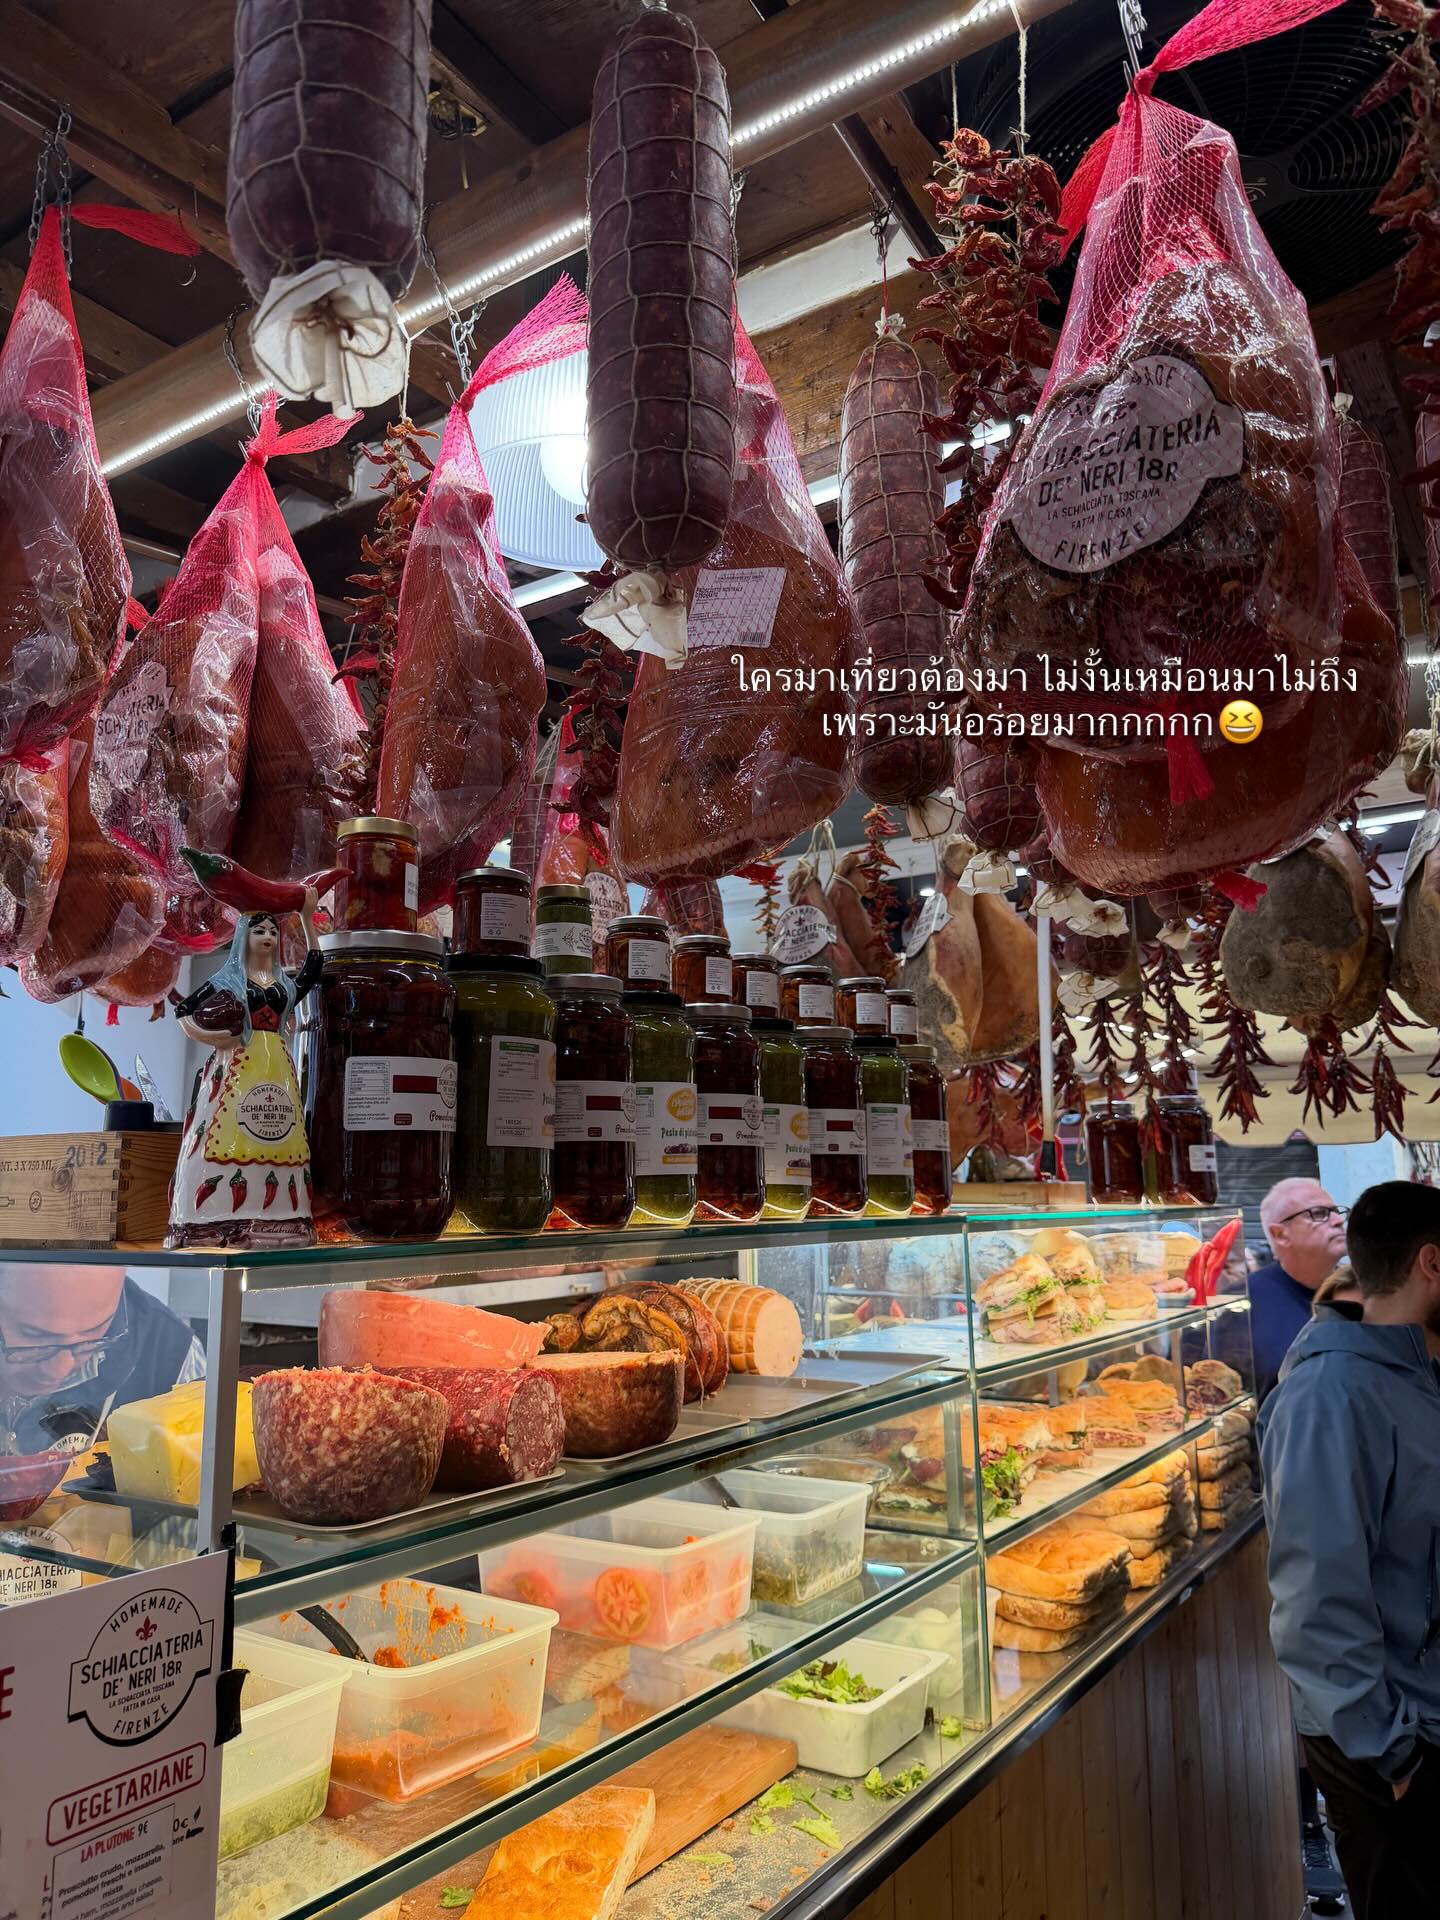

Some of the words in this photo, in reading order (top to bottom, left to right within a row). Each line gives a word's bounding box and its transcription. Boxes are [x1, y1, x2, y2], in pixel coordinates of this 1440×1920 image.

[1038, 476, 1072, 507] DE'
[1081, 460, 1126, 497] NERI
[1136, 455, 1179, 483] 18R
[1061, 495, 1114, 518] SCHIACCIATA
[1118, 487, 1161, 502] TOSCANA
[1071, 515, 1096, 530] FATTA
[1107, 506, 1133, 521] CASA
[240, 1104, 294, 1113] SCHIACCIATERIA
[263, 1113, 277, 1121] NERI
[14, 1580, 37, 1594] NERI
[41, 1579, 58, 1590] 18R
[110, 1595, 183, 1632] HOMEMADE
[81, 1628, 203, 1685] SCHIACCIATERIA
[103, 1678, 124, 1699] DE'
[128, 1668, 157, 1691] NERI
[162, 1660, 182, 1680] 18R
[108, 1700, 116, 1709] LA
[117, 1688, 151, 1706] SCHIACCIATA
[152, 1680, 175, 1693] TOSCANA
[113, 1703, 169, 1735] FIRENZE
[123, 1702, 139, 1713] FATTA
[147, 1694, 161, 1705] CASA
[64, 1754, 194, 1830] VEGETARIANE
[80, 1845, 93, 1863] LA
[95, 1826, 136, 1855] PLUTONE
[138, 1820, 149, 1837] 9€
[58, 1874, 99, 1898] Prosciutto
[99, 1863, 125, 1881] crudo,
[61, 1883, 99, 1909] pomodori
[100, 1871, 127, 1889] freschi
[133, 1855, 162, 1874] insalata
[102, 1884, 124, 1900] mista
[100, 1888, 137, 1909] mozzarella
[120, 1897, 135, 1910] and
[135, 1888, 154, 1904] salad
